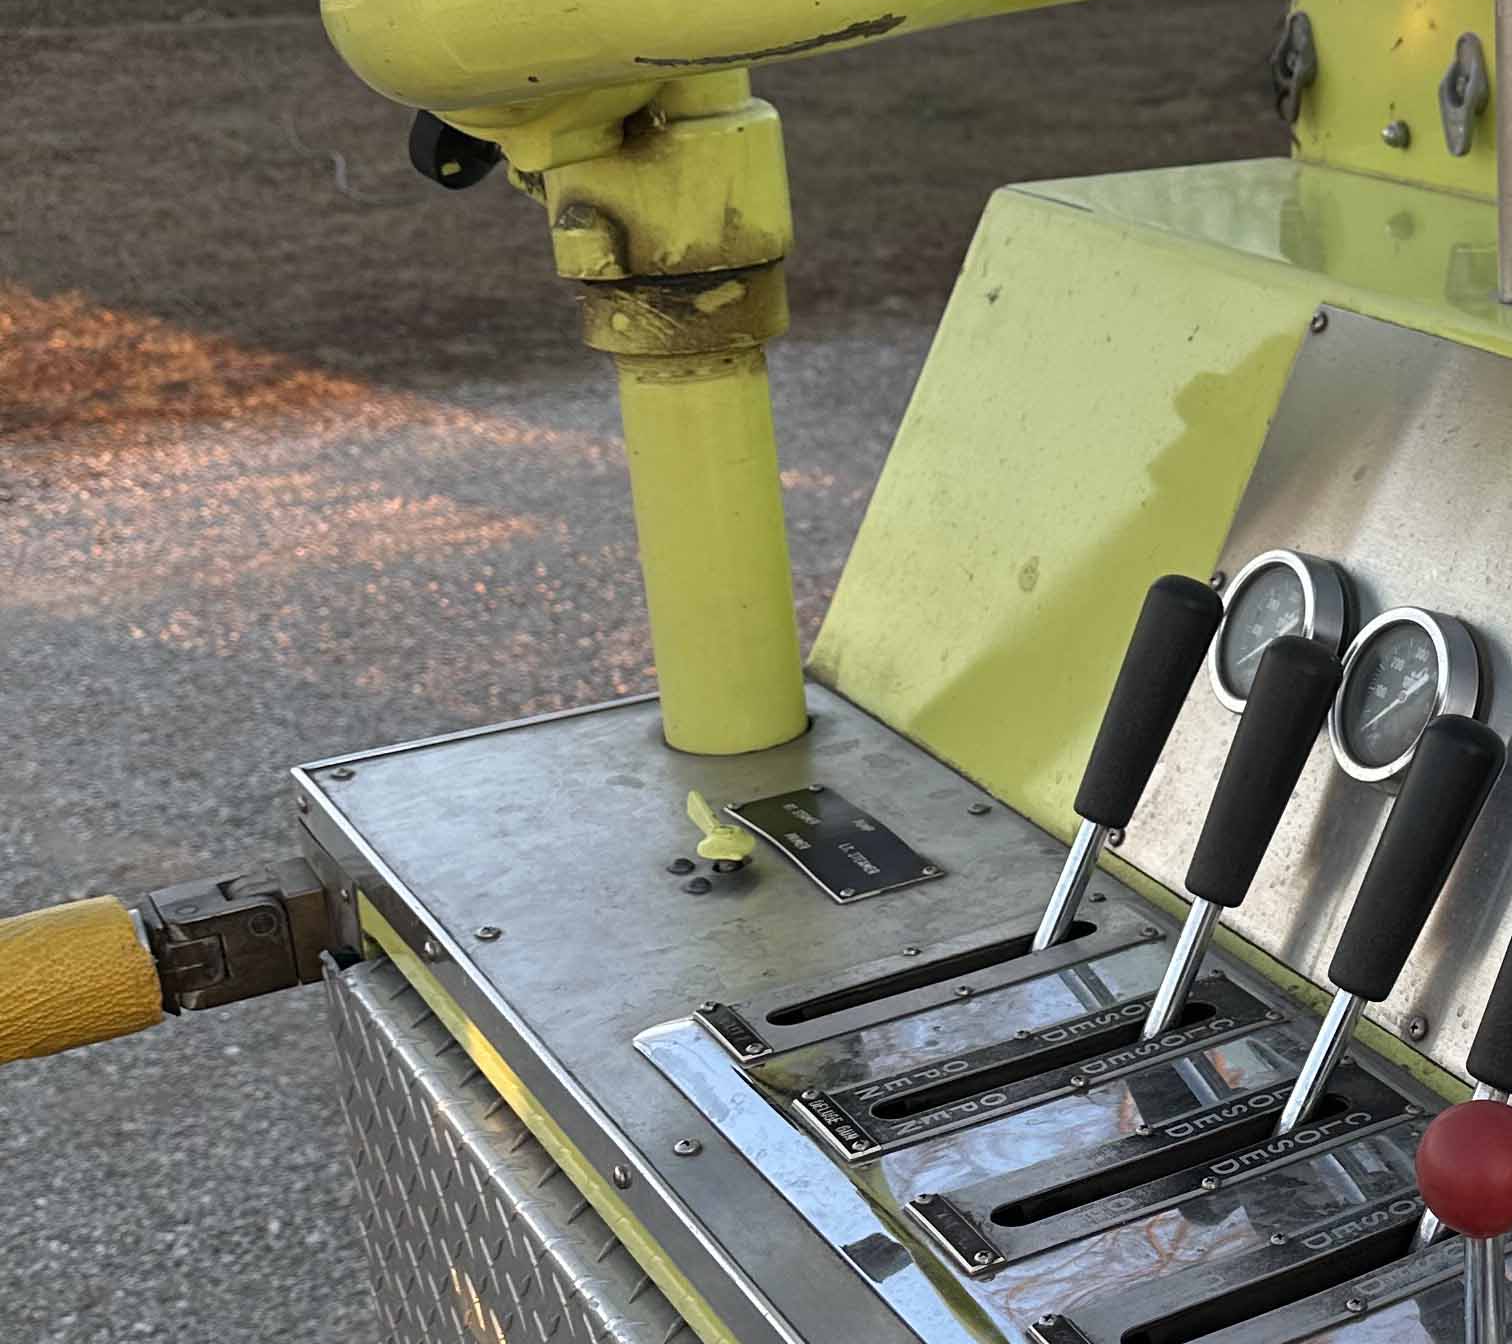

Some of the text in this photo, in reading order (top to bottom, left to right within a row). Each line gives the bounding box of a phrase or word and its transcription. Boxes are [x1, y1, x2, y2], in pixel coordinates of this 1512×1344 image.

[1080, 1017, 1235, 1075] CLOSED
[854, 1059, 969, 1101] OPEN
[808, 1099, 844, 1125] DELUGE
[888, 1092, 1007, 1135] OPEN
[1165, 1086, 1294, 1138] LOSED
[1211, 1112, 1372, 1176] CLOSED
